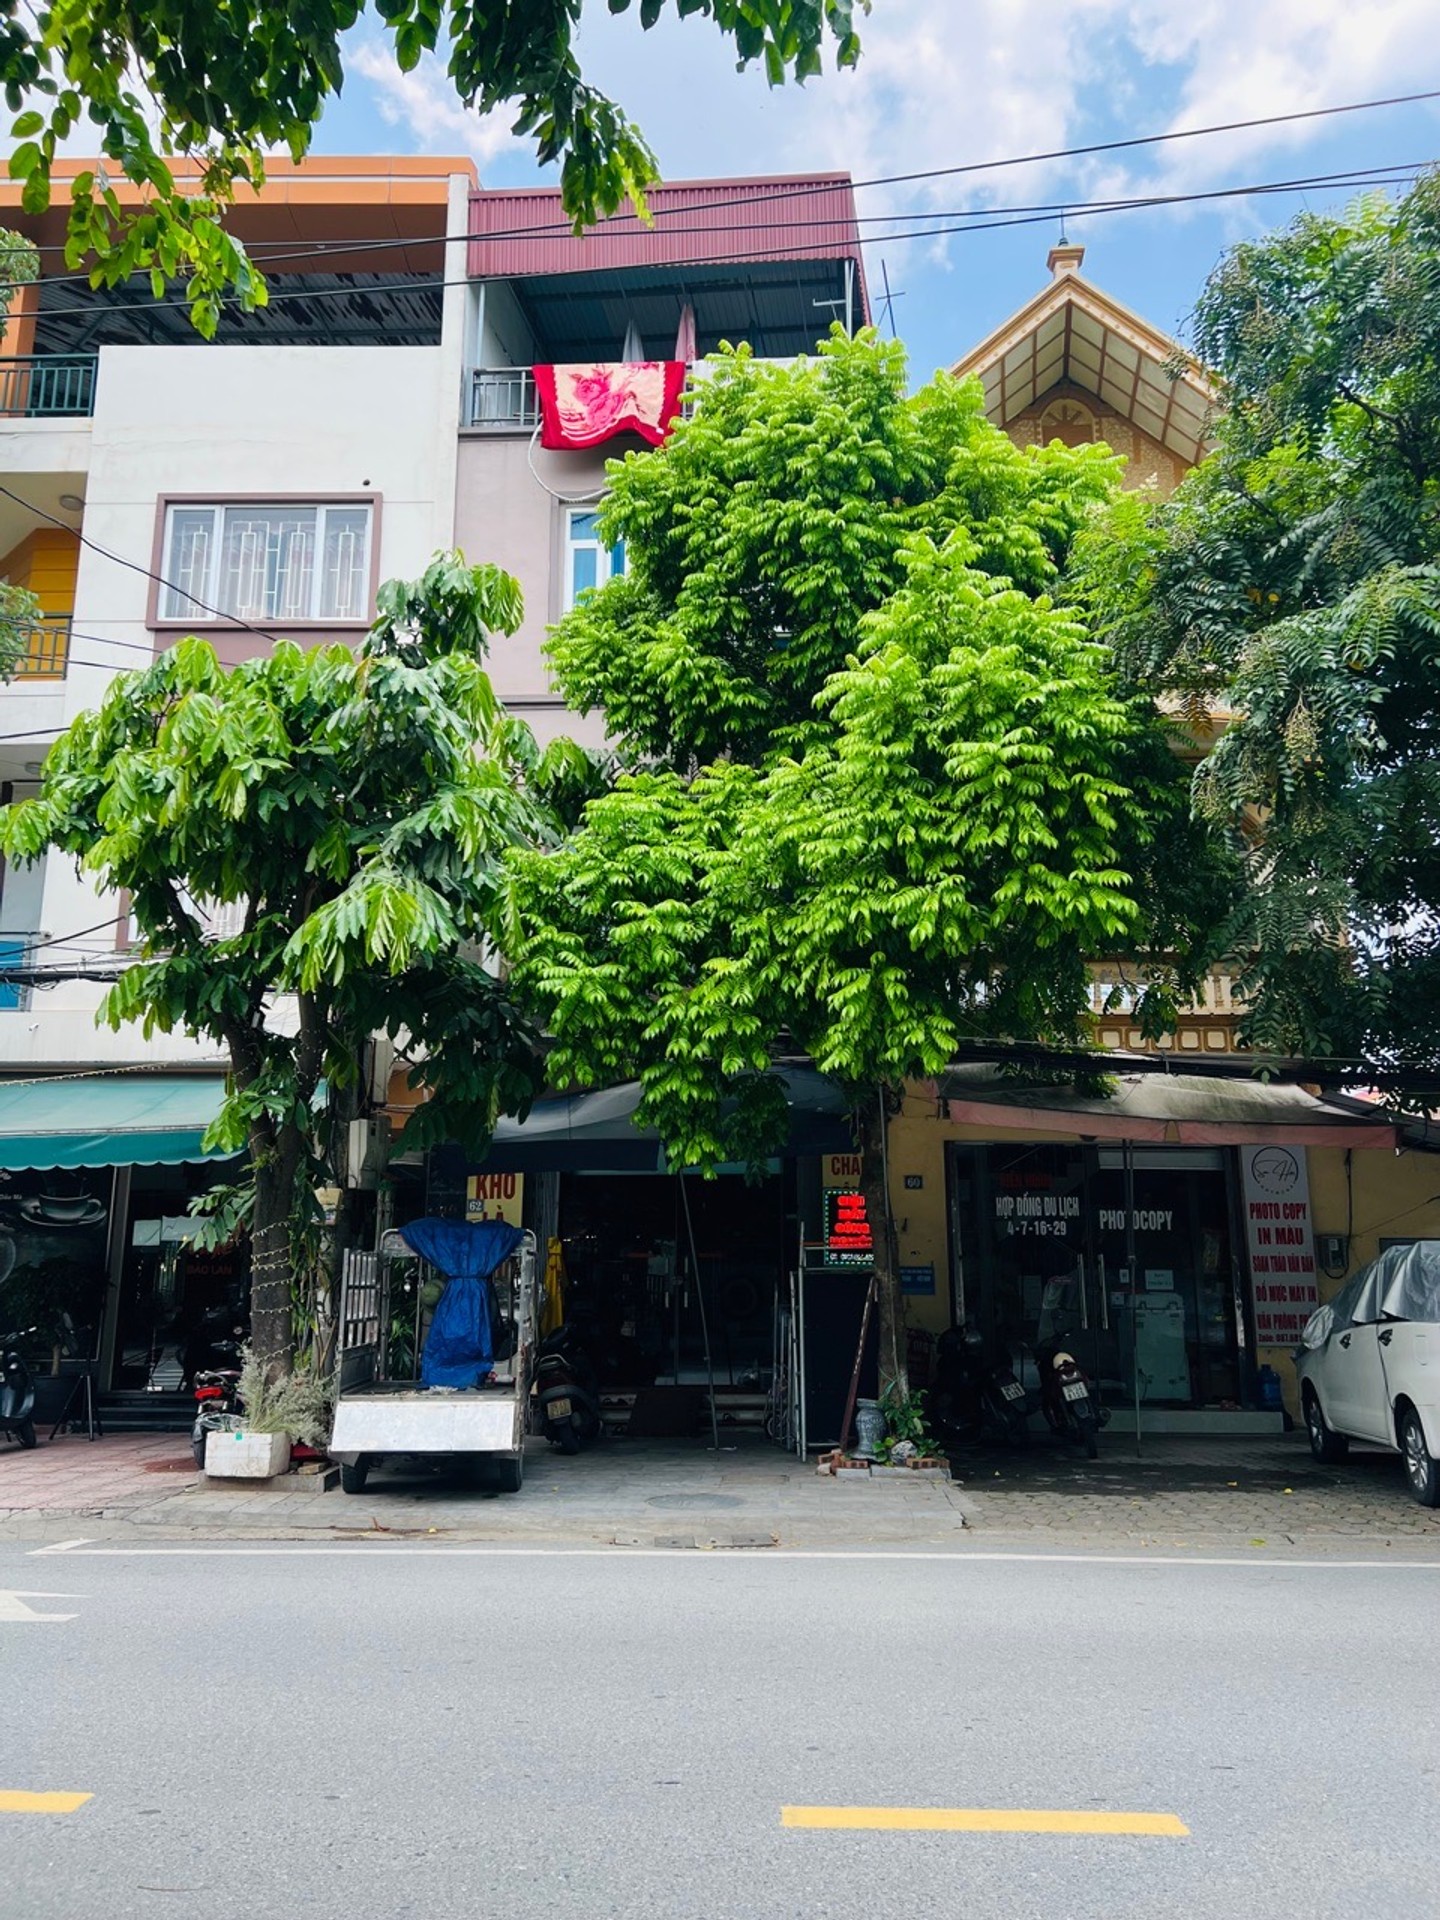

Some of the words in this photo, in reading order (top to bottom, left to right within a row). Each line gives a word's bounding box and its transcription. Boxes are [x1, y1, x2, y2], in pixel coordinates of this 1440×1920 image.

[831, 1156, 864, 1176] CHA
[906, 1177, 921, 1188] 60
[469, 1200, 483, 1211] 62
[1058, 1196, 1080, 1219] LỊCH
[1250, 1203, 1280, 1220] PHOTO
[1283, 1203, 1306, 1220] COPY
[1099, 1209, 1173, 1231] PHOOCOPY
[1257, 1227, 1271, 1245] IN
[1275, 1224, 1304, 1245] MÀU
